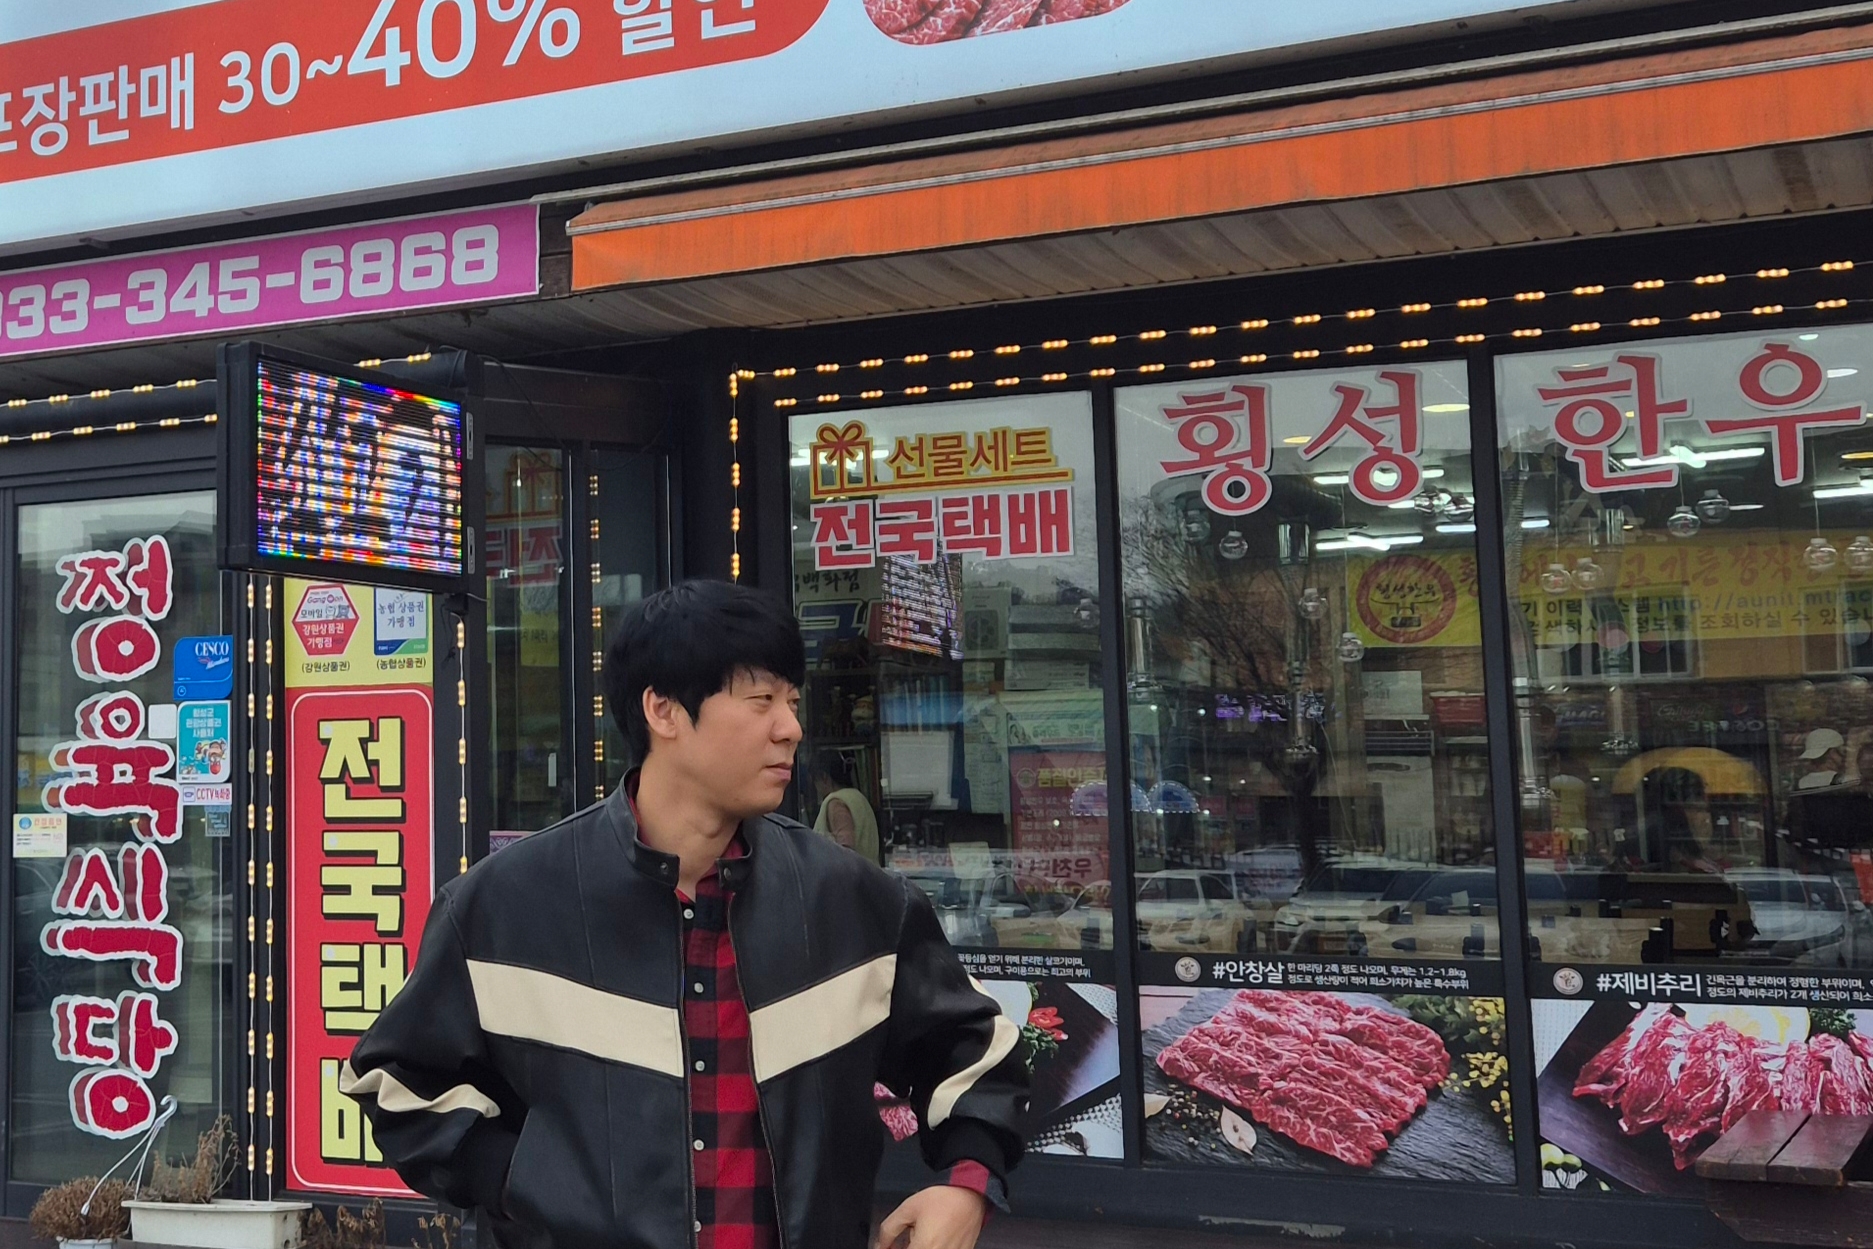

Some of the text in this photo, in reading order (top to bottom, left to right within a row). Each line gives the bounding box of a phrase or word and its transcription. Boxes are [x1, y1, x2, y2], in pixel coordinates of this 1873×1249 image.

[0, 223, 499, 340] 33-345-6868
[886, 427, 1056, 481] 선물세트
[811, 486, 1075, 572] 전국택배
[795, 568, 861, 594] 백화점
[302, 622, 345, 636] 강원상품권
[195, 641, 229, 656] CESCO
[306, 637, 333, 649] 가맹점
[41, 534, 185, 1140] 정육식당
[1212, 960, 1285, 984] #안창살
[1596, 972, 1702, 998] #제비추리
